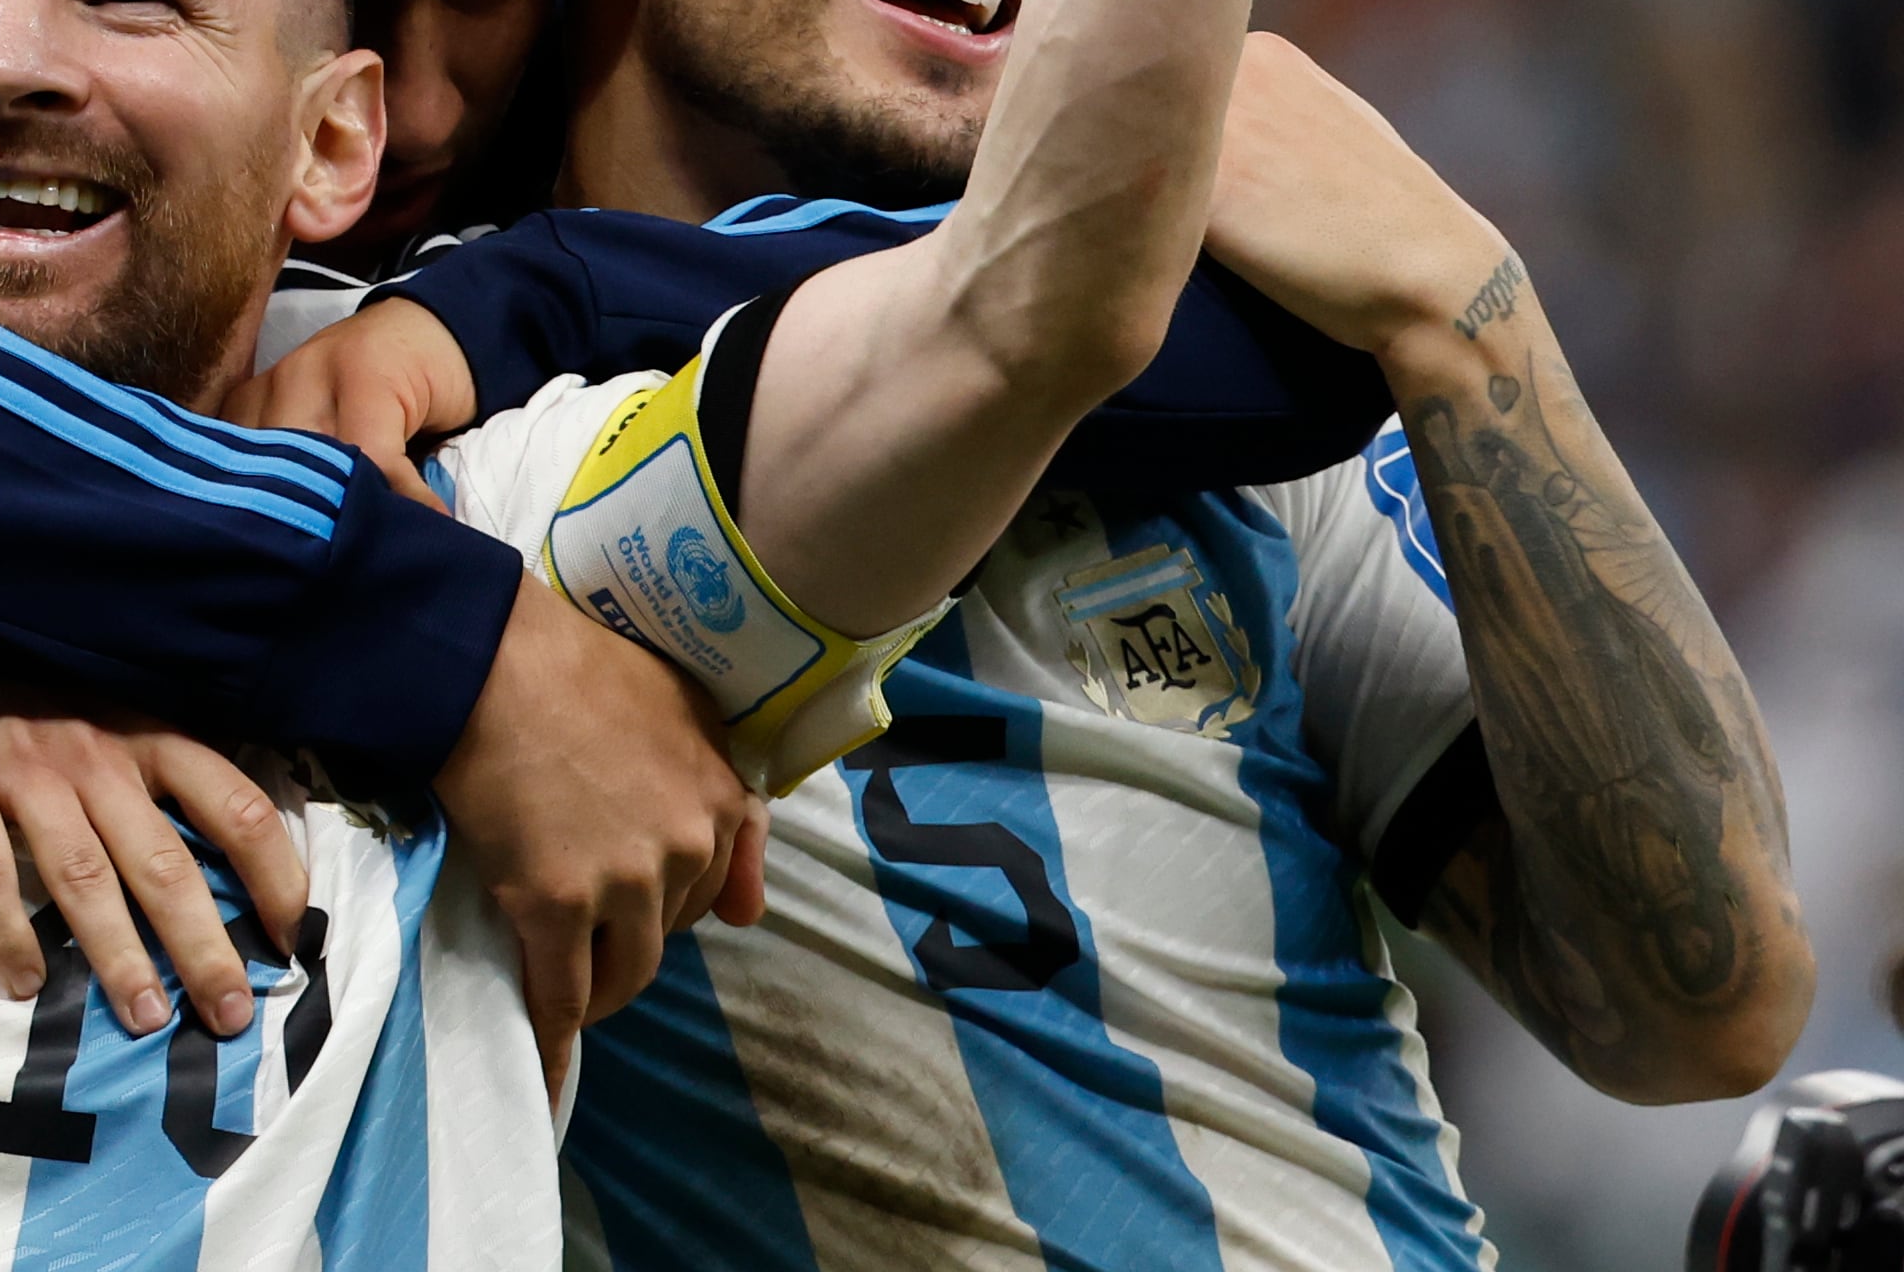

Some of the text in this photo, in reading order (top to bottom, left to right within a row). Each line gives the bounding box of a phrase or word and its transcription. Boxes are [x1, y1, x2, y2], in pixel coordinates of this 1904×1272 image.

[618, 536, 724, 675] Organization
[632, 525, 734, 670] World Health
[1110, 603, 1212, 691] AFA
[842, 716, 1080, 991] 5
